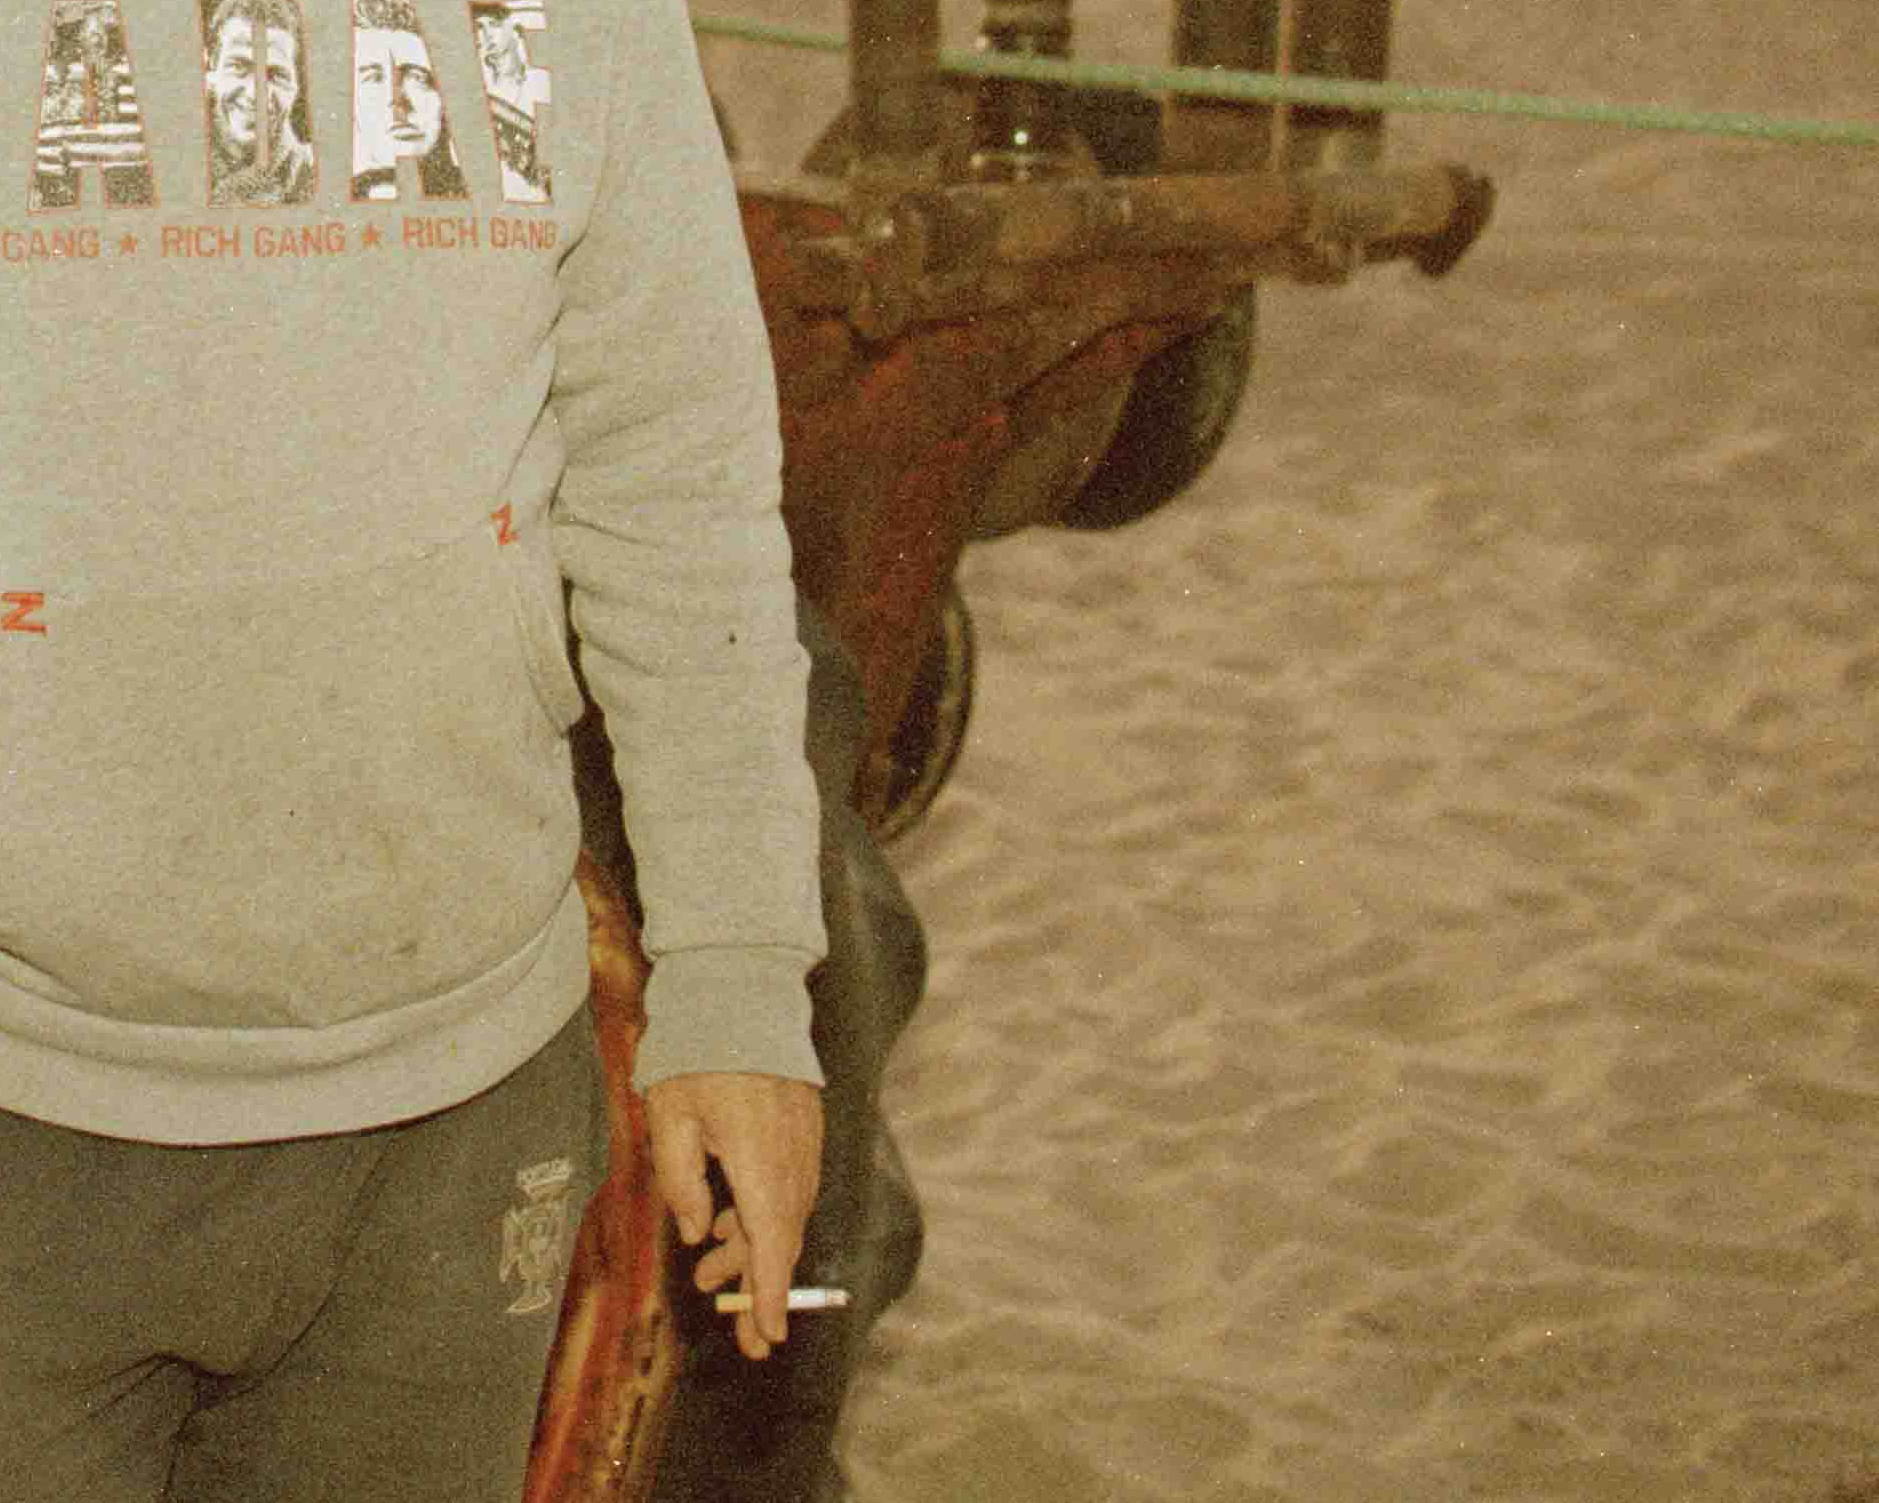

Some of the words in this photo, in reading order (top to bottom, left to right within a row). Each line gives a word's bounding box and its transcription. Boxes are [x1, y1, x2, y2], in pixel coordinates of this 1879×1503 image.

[1, 224, 101, 263] GANG
[160, 223, 241, 259] RICH
[254, 219, 346, 259] GANG
[401, 215, 479, 250] RICH
[488, 215, 557, 249] GANG
